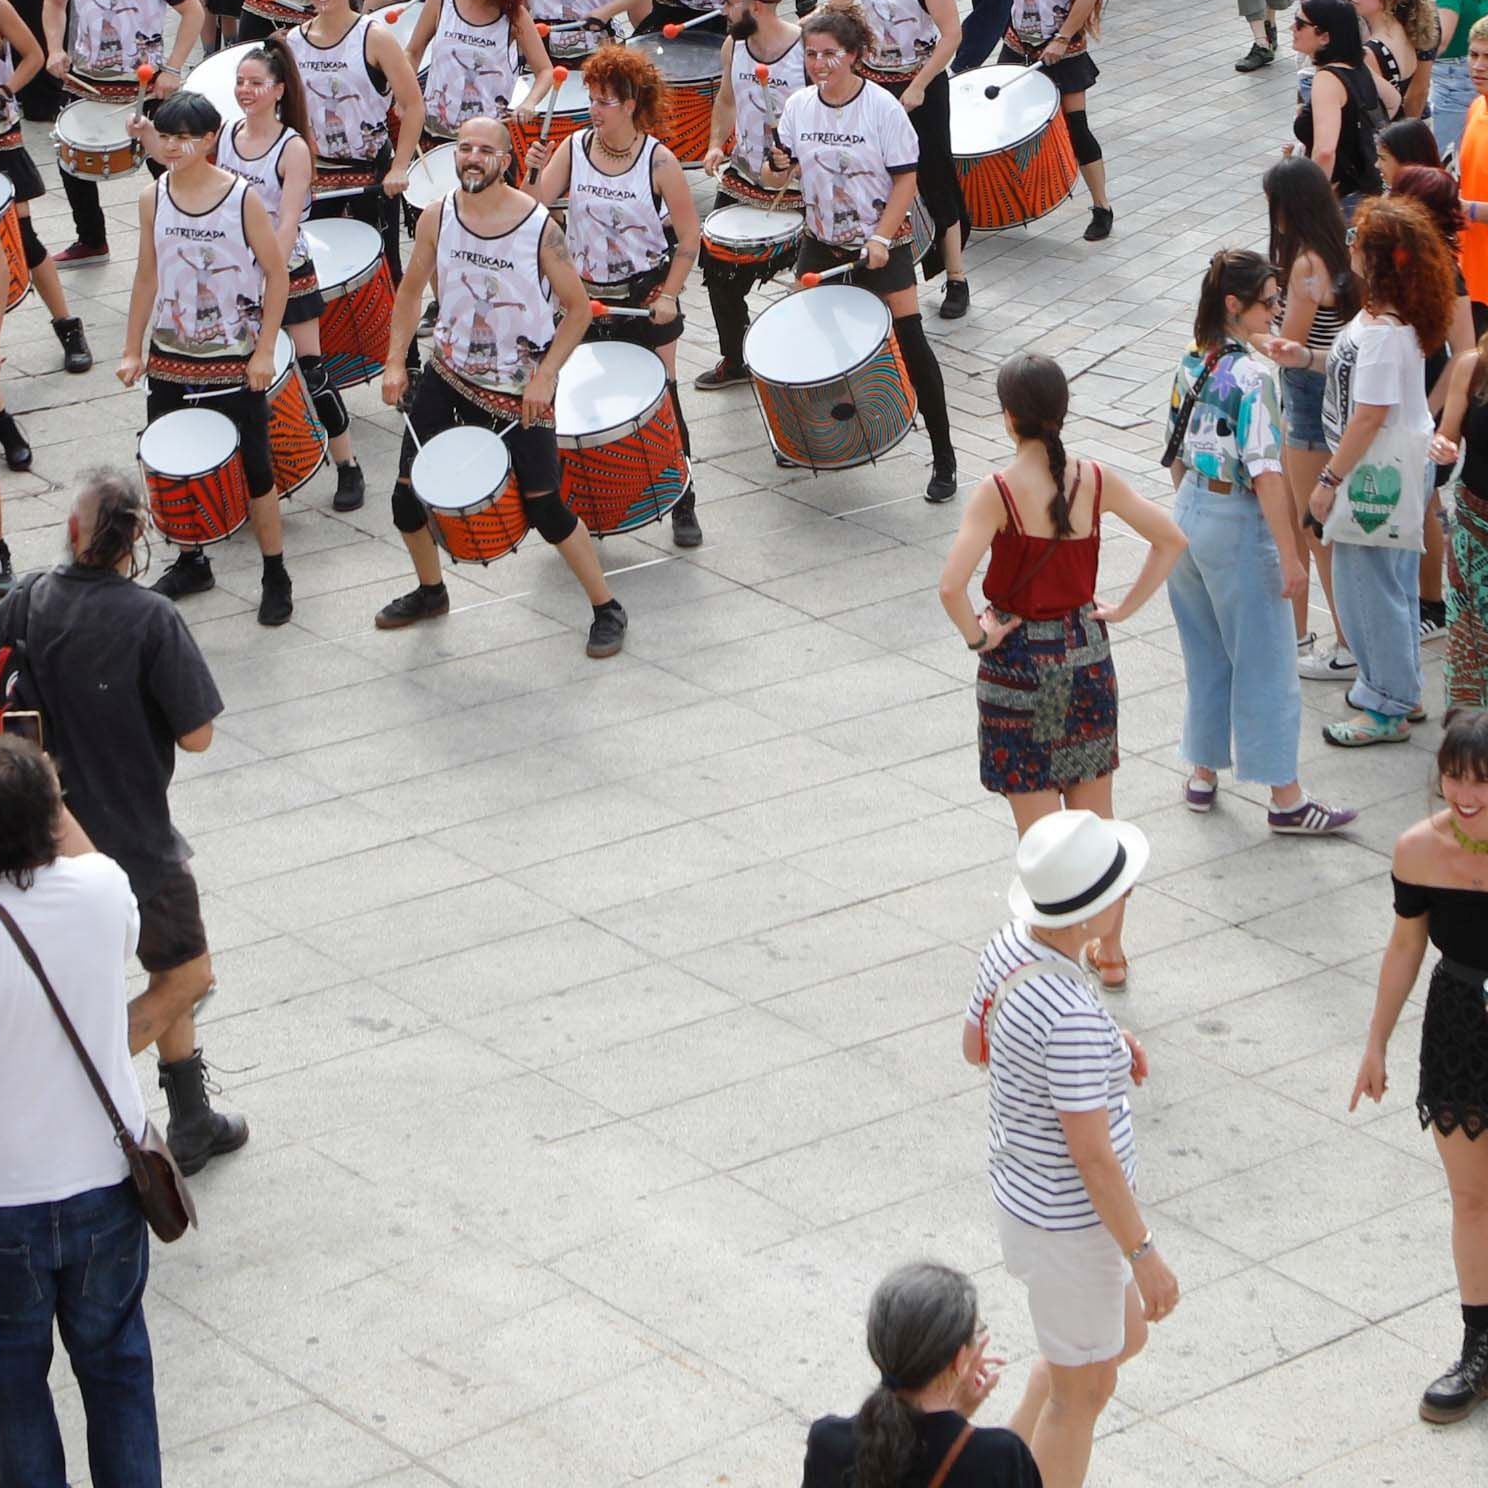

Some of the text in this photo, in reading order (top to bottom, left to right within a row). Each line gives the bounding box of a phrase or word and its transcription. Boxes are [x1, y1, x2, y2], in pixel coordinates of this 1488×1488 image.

[444, 30, 497, 48] EXTRETUCADA
[799, 132, 866, 144] EXTRETUCADA
[577, 183, 637, 199] EXTRETUCADA
[165, 227, 227, 240] EXTRETUCADA
[451, 249, 515, 271] EXTRETUCADA
